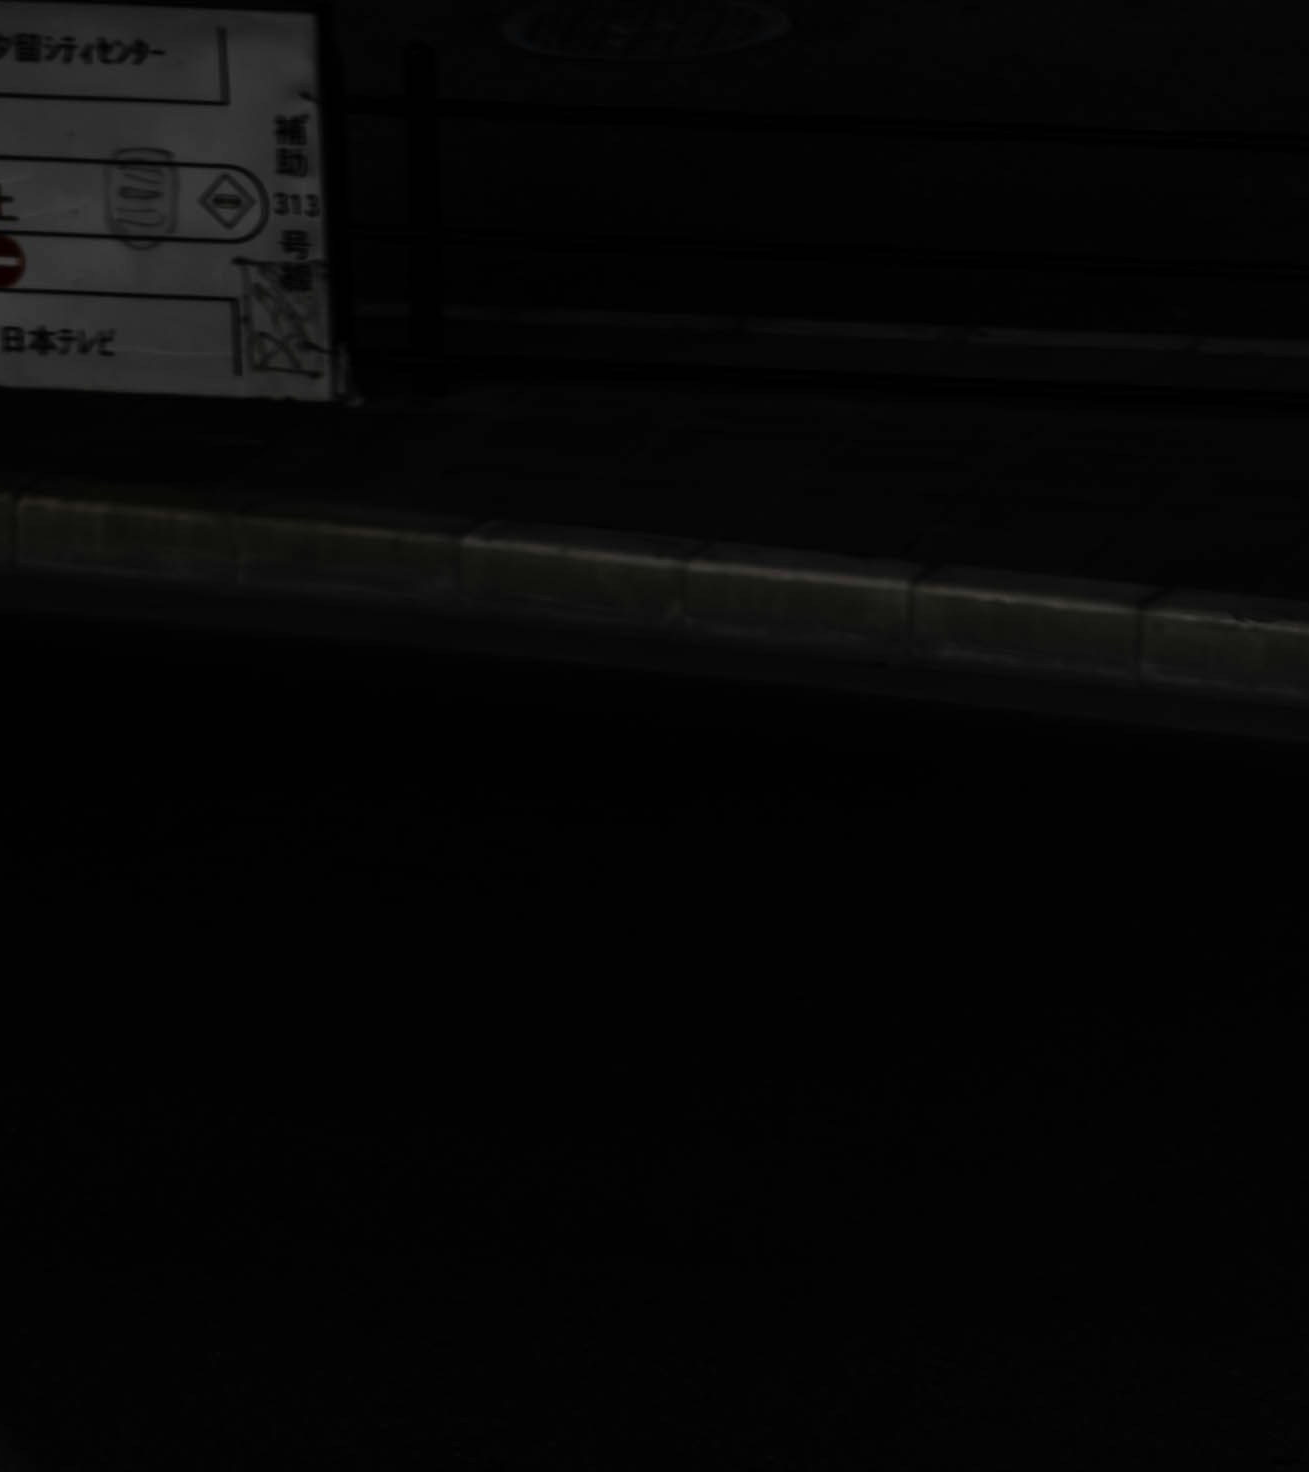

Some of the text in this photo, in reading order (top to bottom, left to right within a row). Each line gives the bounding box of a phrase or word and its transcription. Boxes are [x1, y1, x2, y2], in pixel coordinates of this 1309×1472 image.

[2, 326, 116, 356] 日本テレビ
